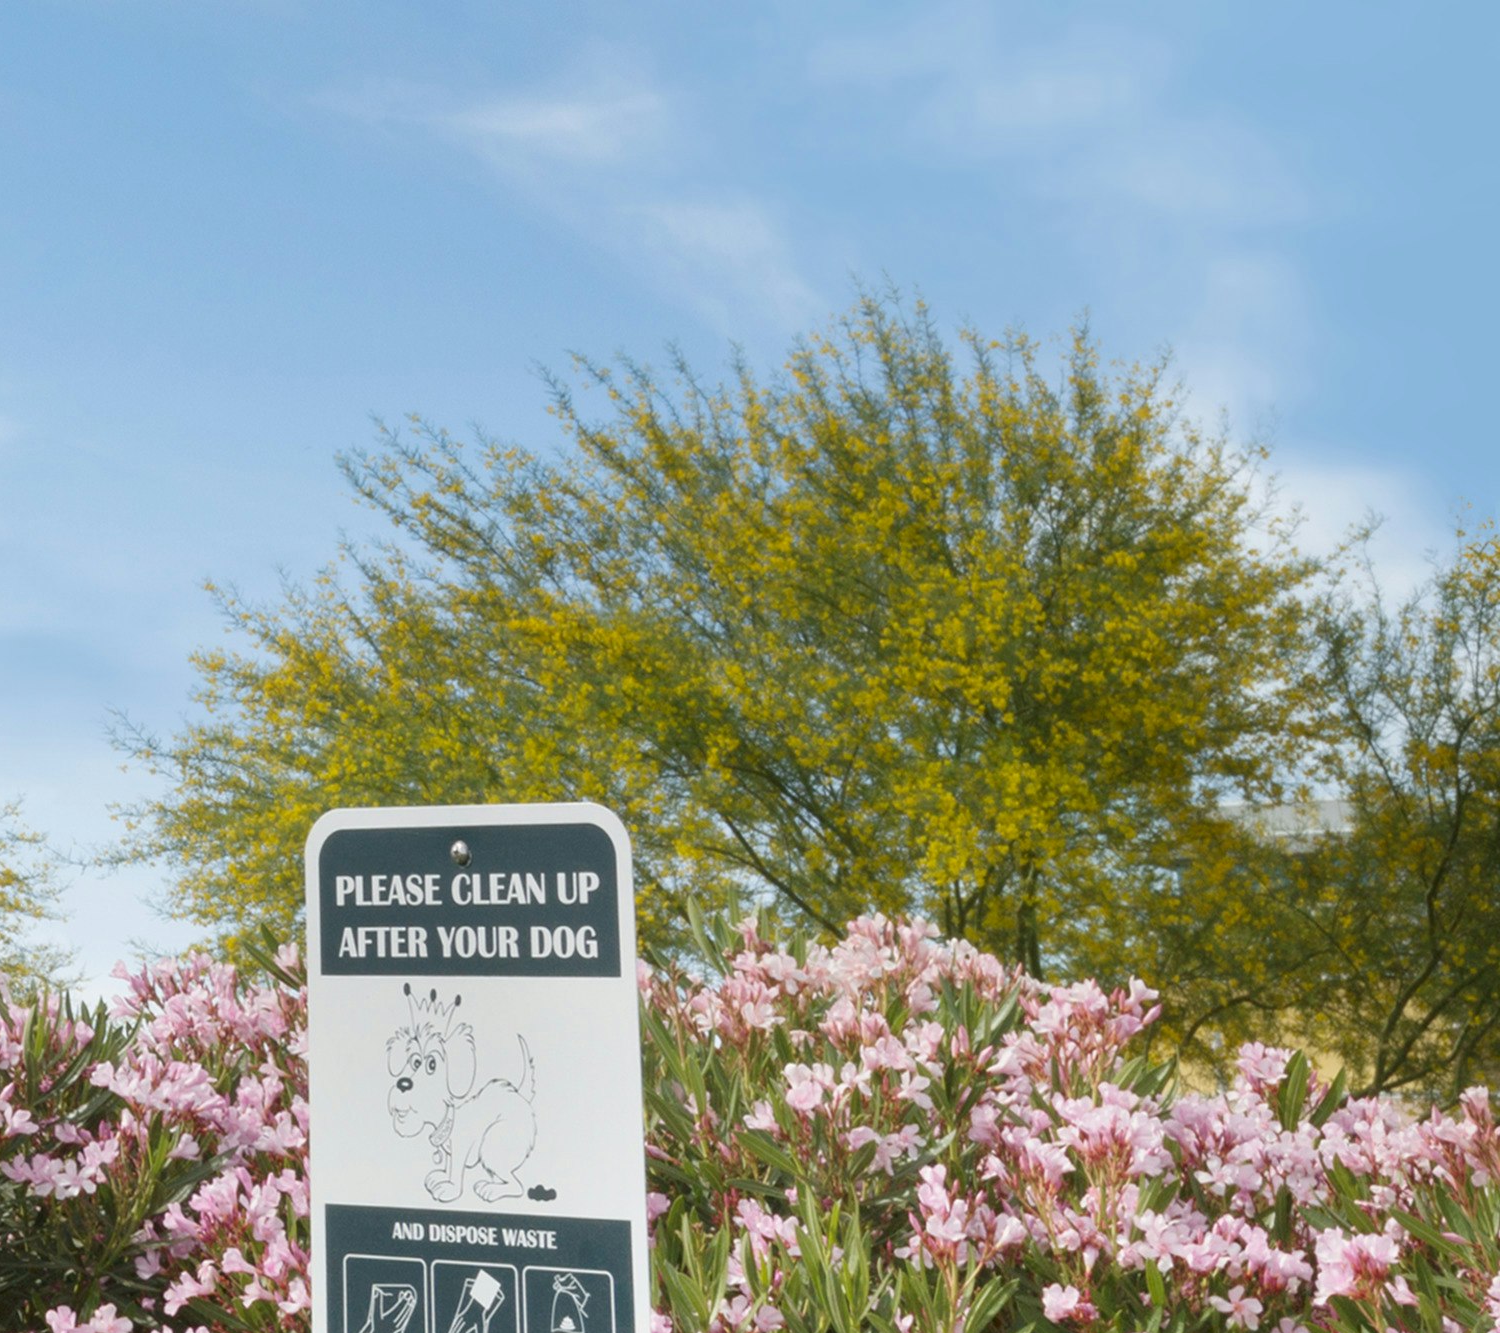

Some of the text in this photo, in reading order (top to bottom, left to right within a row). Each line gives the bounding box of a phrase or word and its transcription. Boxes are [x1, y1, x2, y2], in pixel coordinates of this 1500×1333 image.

[335, 871, 600, 906] PLEASE CLEAN UP
[339, 926, 599, 958] AFTER YOUR DOG
[392, 1222, 557, 1249] AND DISPOSE WASTE
